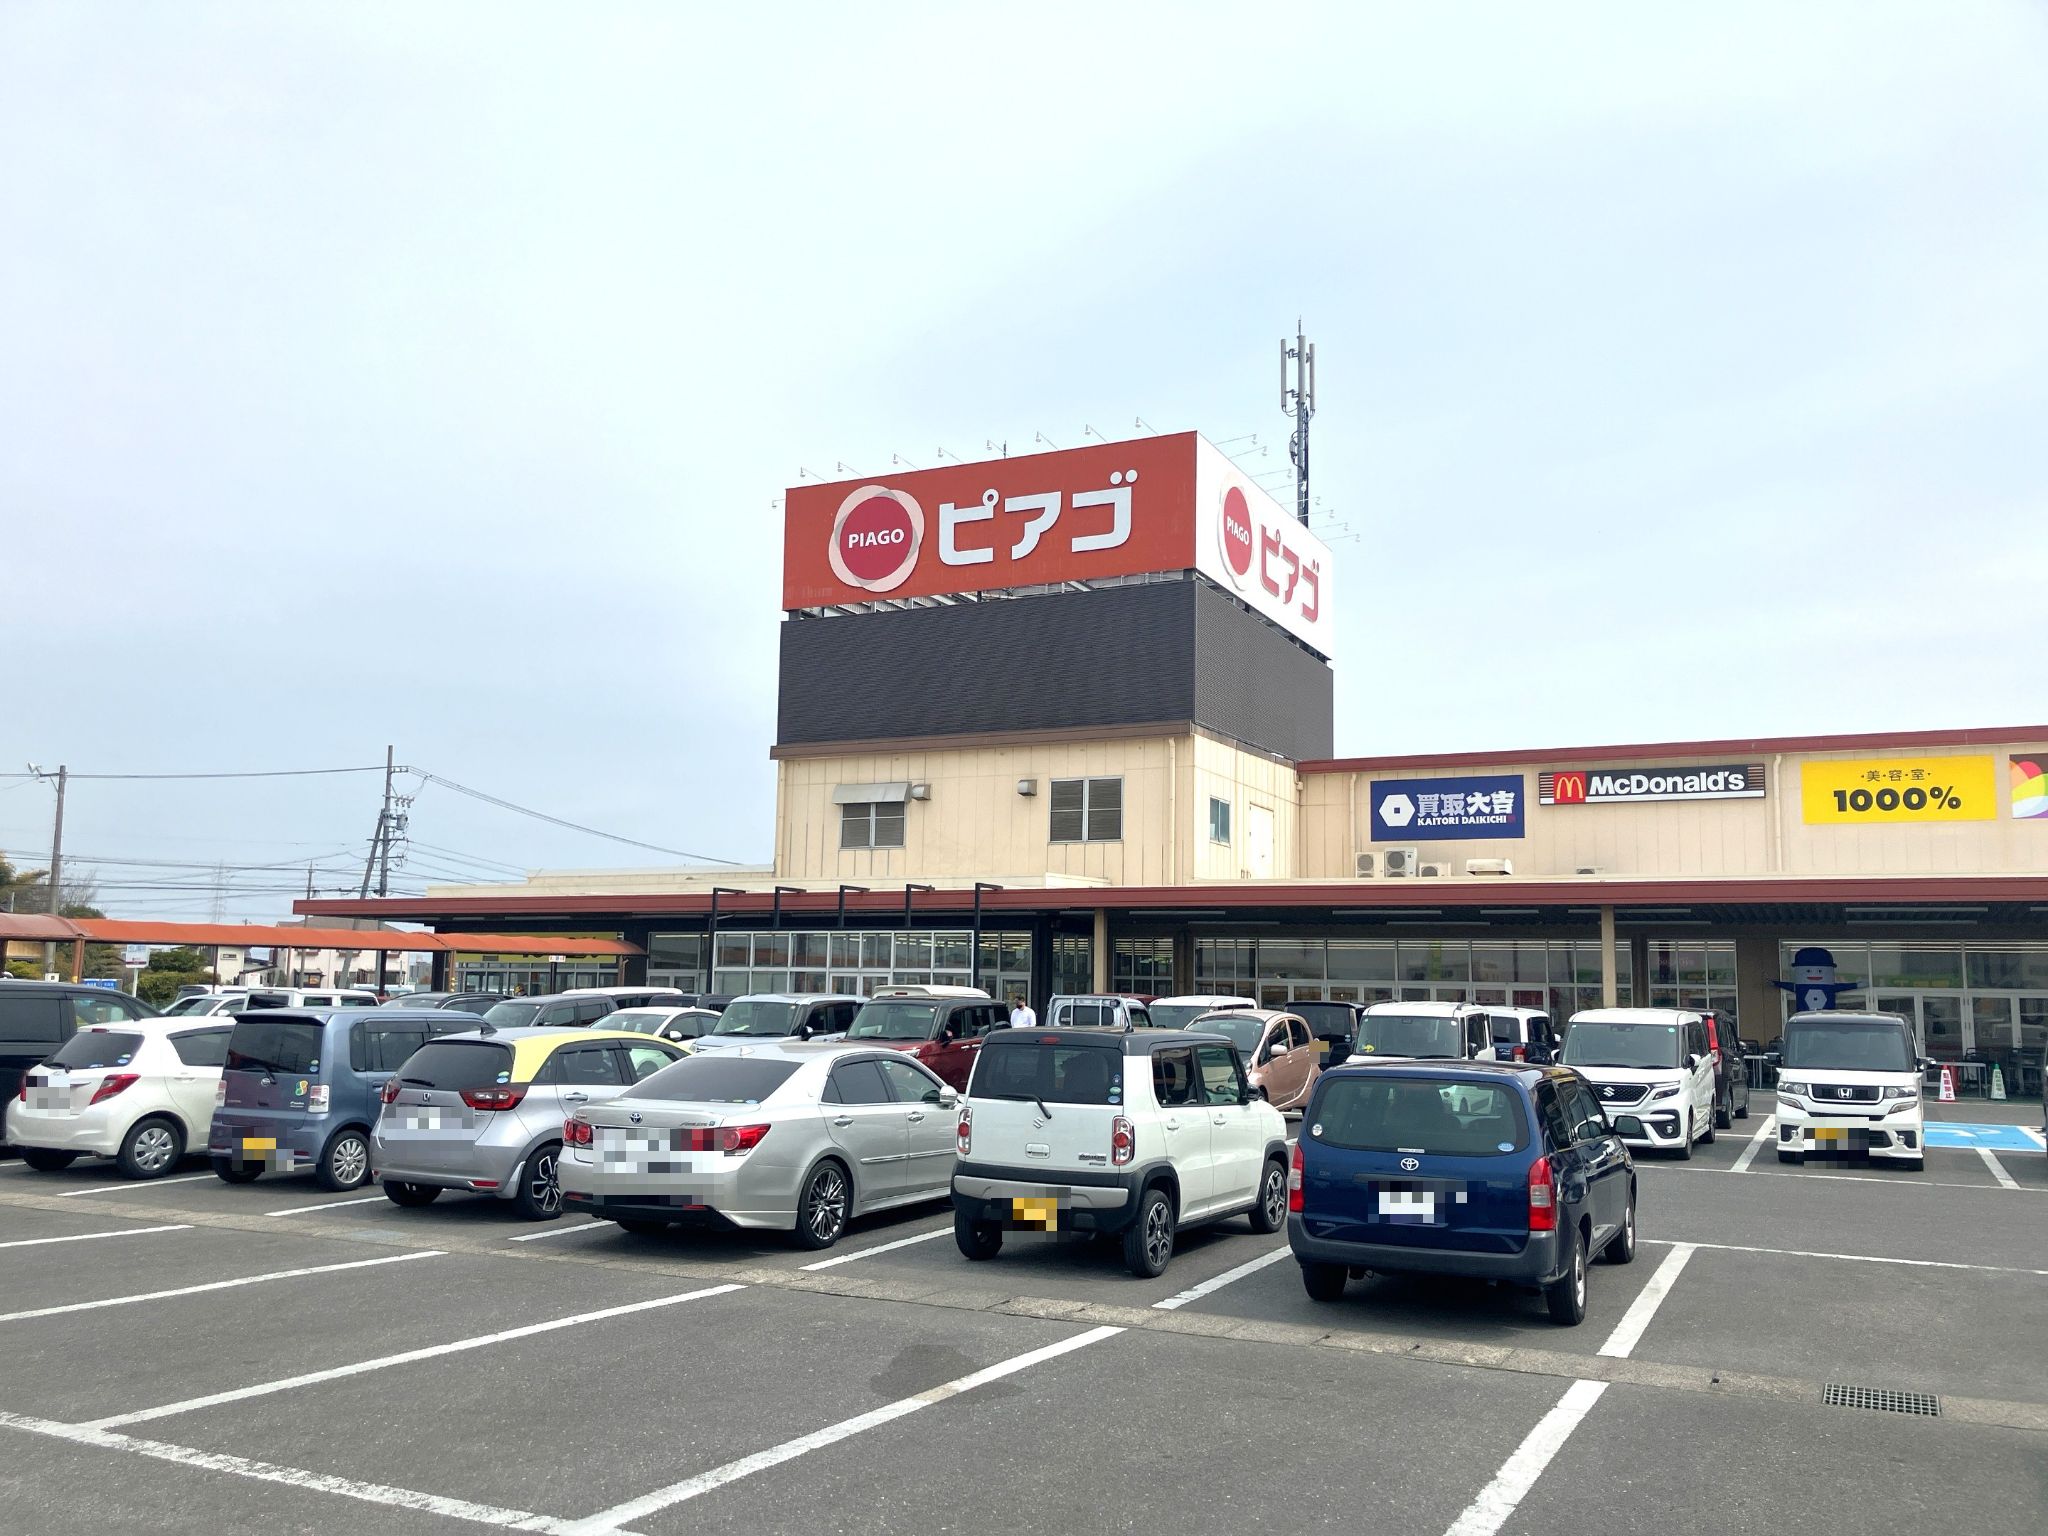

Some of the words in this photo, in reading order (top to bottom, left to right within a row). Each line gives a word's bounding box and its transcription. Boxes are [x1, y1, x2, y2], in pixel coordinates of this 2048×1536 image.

[939, 468, 1138, 566] ピアゴ
[848, 528, 905, 548] PIAGO
[1226, 516, 1250, 546] PIAGO
[1260, 524, 1320, 624] ピアゴ
[1589, 771, 1745, 795] McDonald's
[1416, 790, 1515, 818] 買取大吉
[1833, 786, 1962, 812] 1000%
[1417, 817, 1459, 826] KAITORI
[1462, 815, 1507, 825] DAIKICHI
